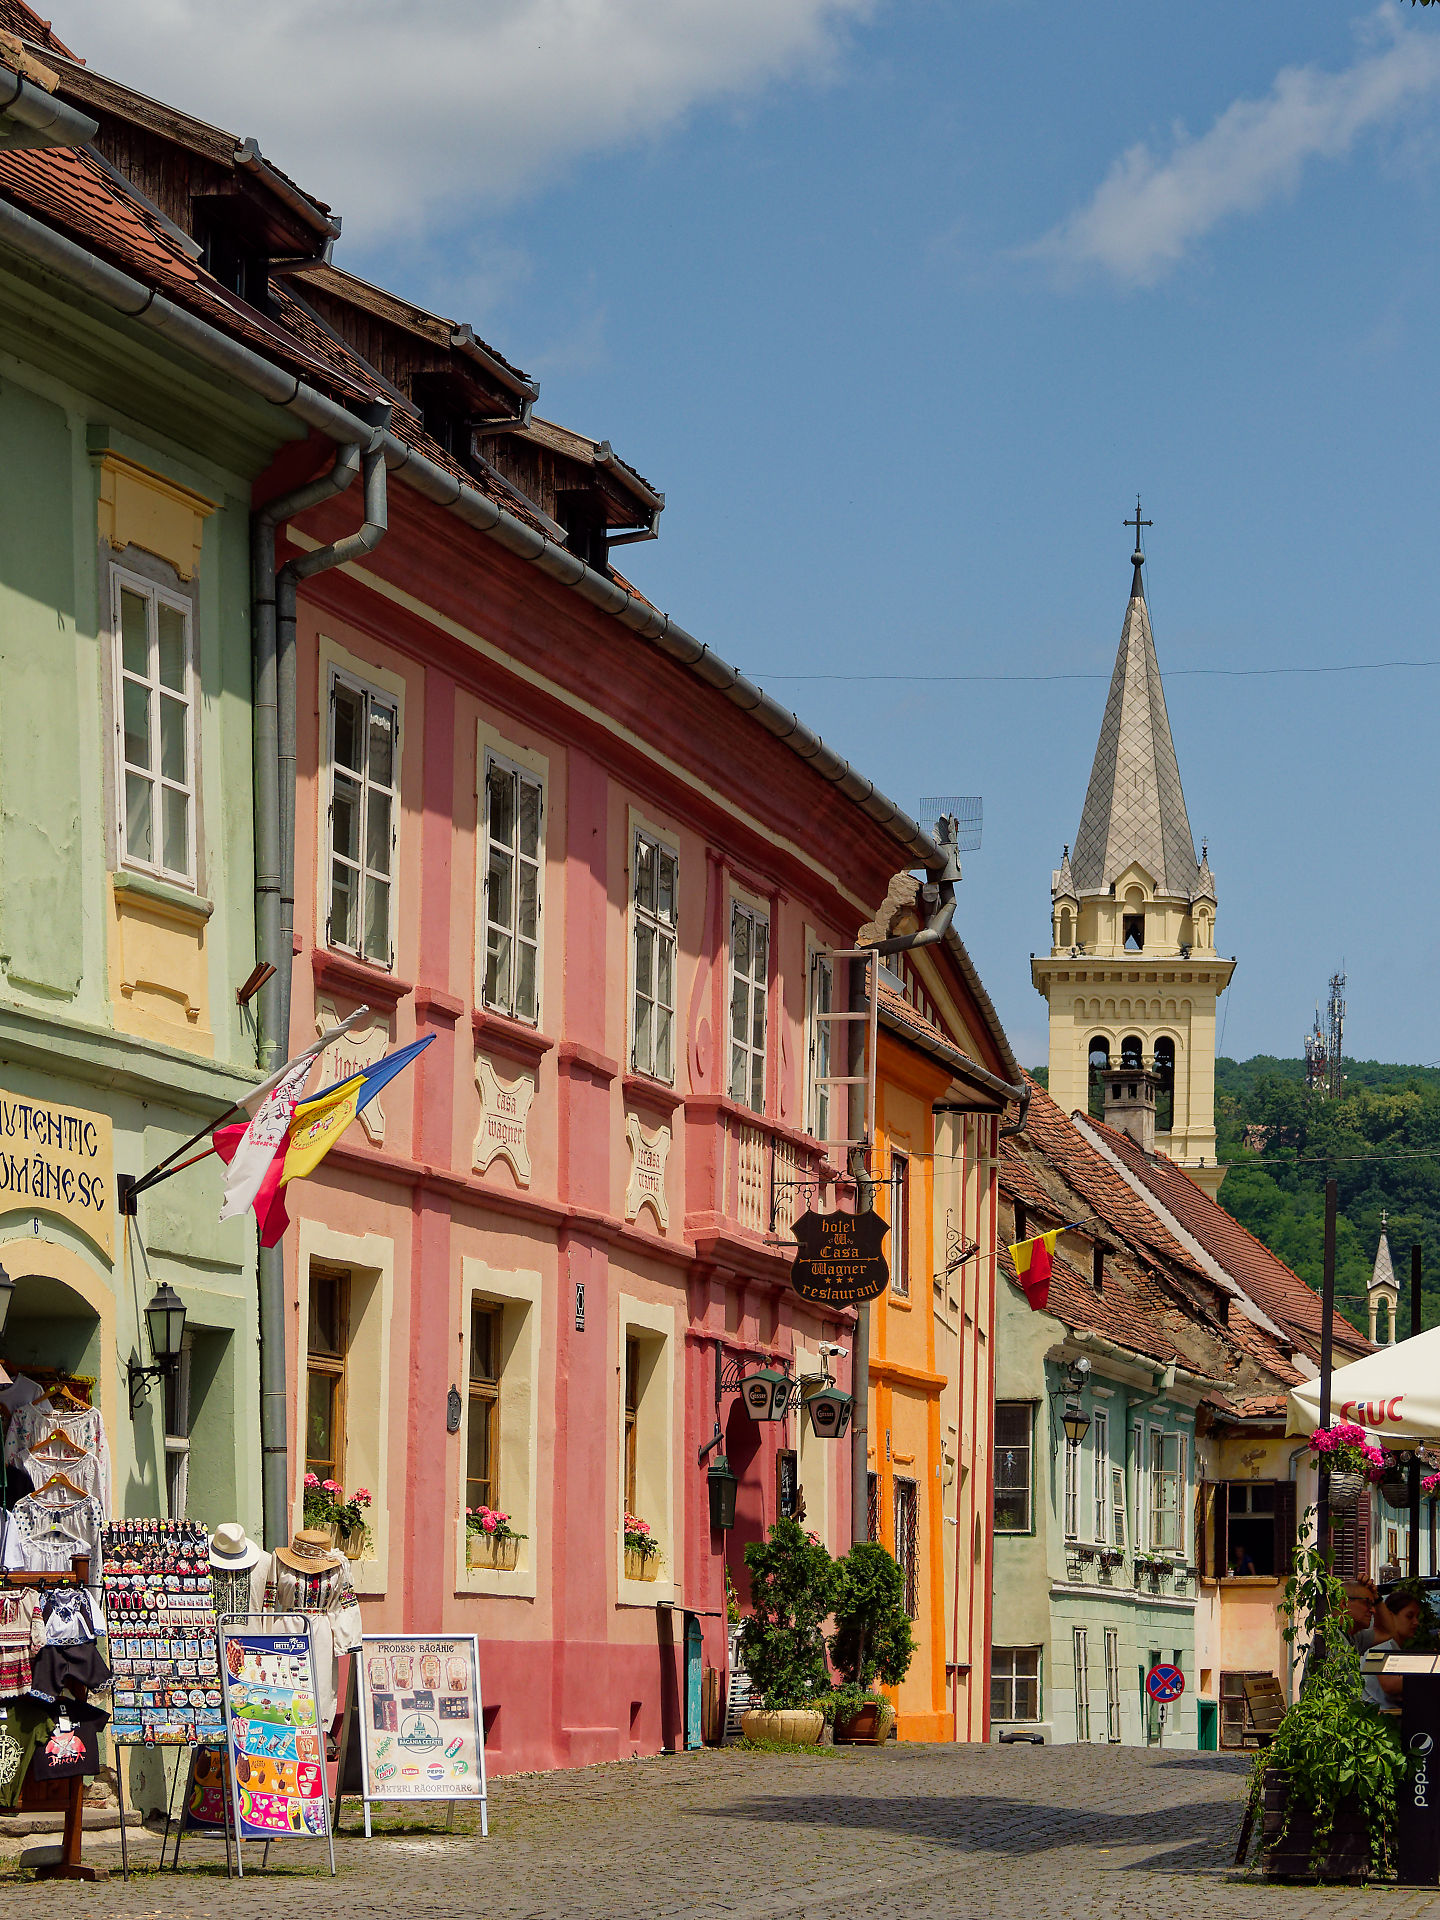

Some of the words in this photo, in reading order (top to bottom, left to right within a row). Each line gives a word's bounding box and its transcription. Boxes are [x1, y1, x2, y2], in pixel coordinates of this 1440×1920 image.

[496, 1093, 516, 1115] casa
[0, 1100, 98, 1157] UTENTIC
[488, 1119, 522, 1145] wagner
[33, 1217, 39, 1234] 6
[822, 1219, 856, 1233] hotel
[820, 1246, 859, 1258] Casa
[811, 1262, 867, 1277] Wagner
[802, 1279, 879, 1300] restaurant
[378, 1644, 416, 1653] PRODUSE
[419, 1643, 455, 1653] BĂCĂNIE
